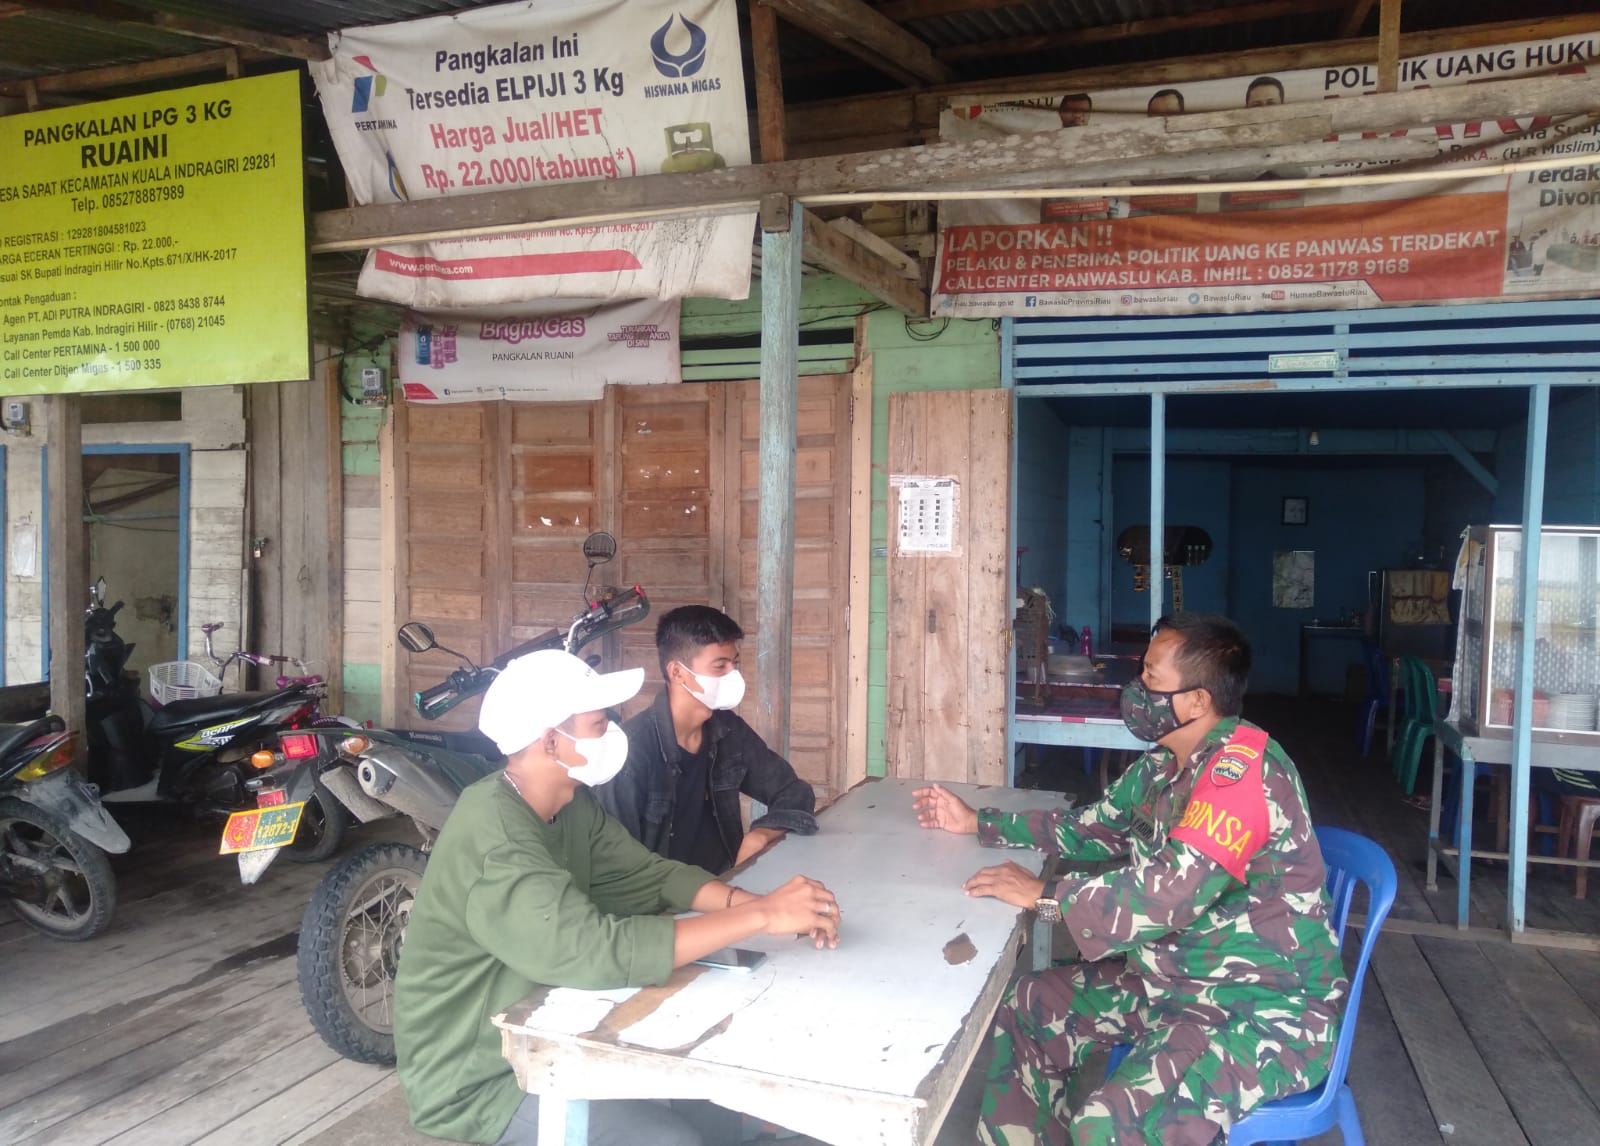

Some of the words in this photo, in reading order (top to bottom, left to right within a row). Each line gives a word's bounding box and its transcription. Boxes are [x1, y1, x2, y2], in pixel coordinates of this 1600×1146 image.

[435, 41, 545, 74] Pangkalan
[552, 32, 579, 58] Ini
[1324, 59, 1428, 90] POLIK
[1436, 50, 1515, 78] UANG
[405, 82, 489, 111] Tersedia
[496, 72, 566, 102] ELPIJI
[573, 70, 587, 94] 3
[594, 67, 624, 97] Kg
[644, 82, 689, 98] HISWANA
[691, 78, 721, 94] MIGAS
[24, 114, 136, 147] PANGKALAN
[143, 107, 178, 129] LPG
[186, 104, 196, 124] 3
[204, 99, 232, 122] KG
[429, 122, 496, 153] Harga
[502, 107, 603, 143] Jual/HET
[81, 134, 168, 169] RUAINI
[23, 182, 57, 198] SAPAT
[60, 171, 129, 194] KECAMATAN
[132, 166, 172, 184] KUALA
[174, 158, 239, 179] INDRAGIRI
[242, 153, 276, 171] 29281
[421, 164, 455, 194] Rp.
[72, 197, 99, 214] Telp.
[102, 184, 184, 208] 085278887989
[4, 231, 59, 247] REGISTRASI
[24, 249, 61, 263] ECERAN
[64, 242, 115, 258] TERTINGGI
[123, 240, 140, 253] Rp.
[946, 256, 1011, 272] PELAKU
[1016, 255, 1026, 270] &
[1031, 252, 1122, 269] PENERIMA
[1127, 247, 1200, 265] POLITIK
[1205, 244, 1260, 262] UANG
[1265, 242, 1291, 258] KE
[1295, 237, 1383, 258] PANWAS
[1389, 230, 1499, 253] TERDEKAT
[949, 226, 1089, 252] LAPORKAN
[20, 269, 33, 280] SK
[35, 266, 62, 279] Bupati
[64, 262, 101, 276] Indragiri
[104, 259, 123, 271] Hilir
[945, 274, 1049, 290] CALLCENTER
[1055, 270, 1150, 288] PANWASLU
[1156, 269, 1198, 284] KAB.
[1204, 266, 1251, 282] INHIL
[1268, 263, 1314, 280] 0852
[1320, 261, 1358, 277] 1178
[1365, 258, 1409, 275] 9168
[3, 313, 25, 327] Agen
[42, 310, 57, 321] ADI
[59, 307, 91, 320] PUTRA
[93, 302, 144, 317] INDRAGIRI
[154, 300, 175, 313] 0823
[178, 297, 200, 310] 8438
[203, 295, 225, 308] 8744
[24, 290, 71, 306] Pengaduan
[3, 332, 40, 345] Layanan
[42, 328, 71, 341] Pemda
[73, 326, 93, 337] Kab.
[95, 321, 135, 336] Indragiri
[138, 320, 158, 332] Hilir
[166, 318, 195, 333] (0768)
[198, 315, 225, 328] 21045
[480, 317, 541, 343] Bright
[543, 316, 585, 338] Gas
[4, 349, 20, 361] Call
[23, 348, 51, 359] Center
[54, 343, 107, 358] PERTAMINA
[123, 341, 140, 352] 500
[143, 339, 160, 351] 000
[492, 352, 543, 361] PANGKALAN
[545, 351, 574, 360] RUAINI
[4, 367, 20, 379] Call
[23, 366, 52, 378] Center
[125, 360, 141, 371] 500
[144, 359, 162, 369] 335
